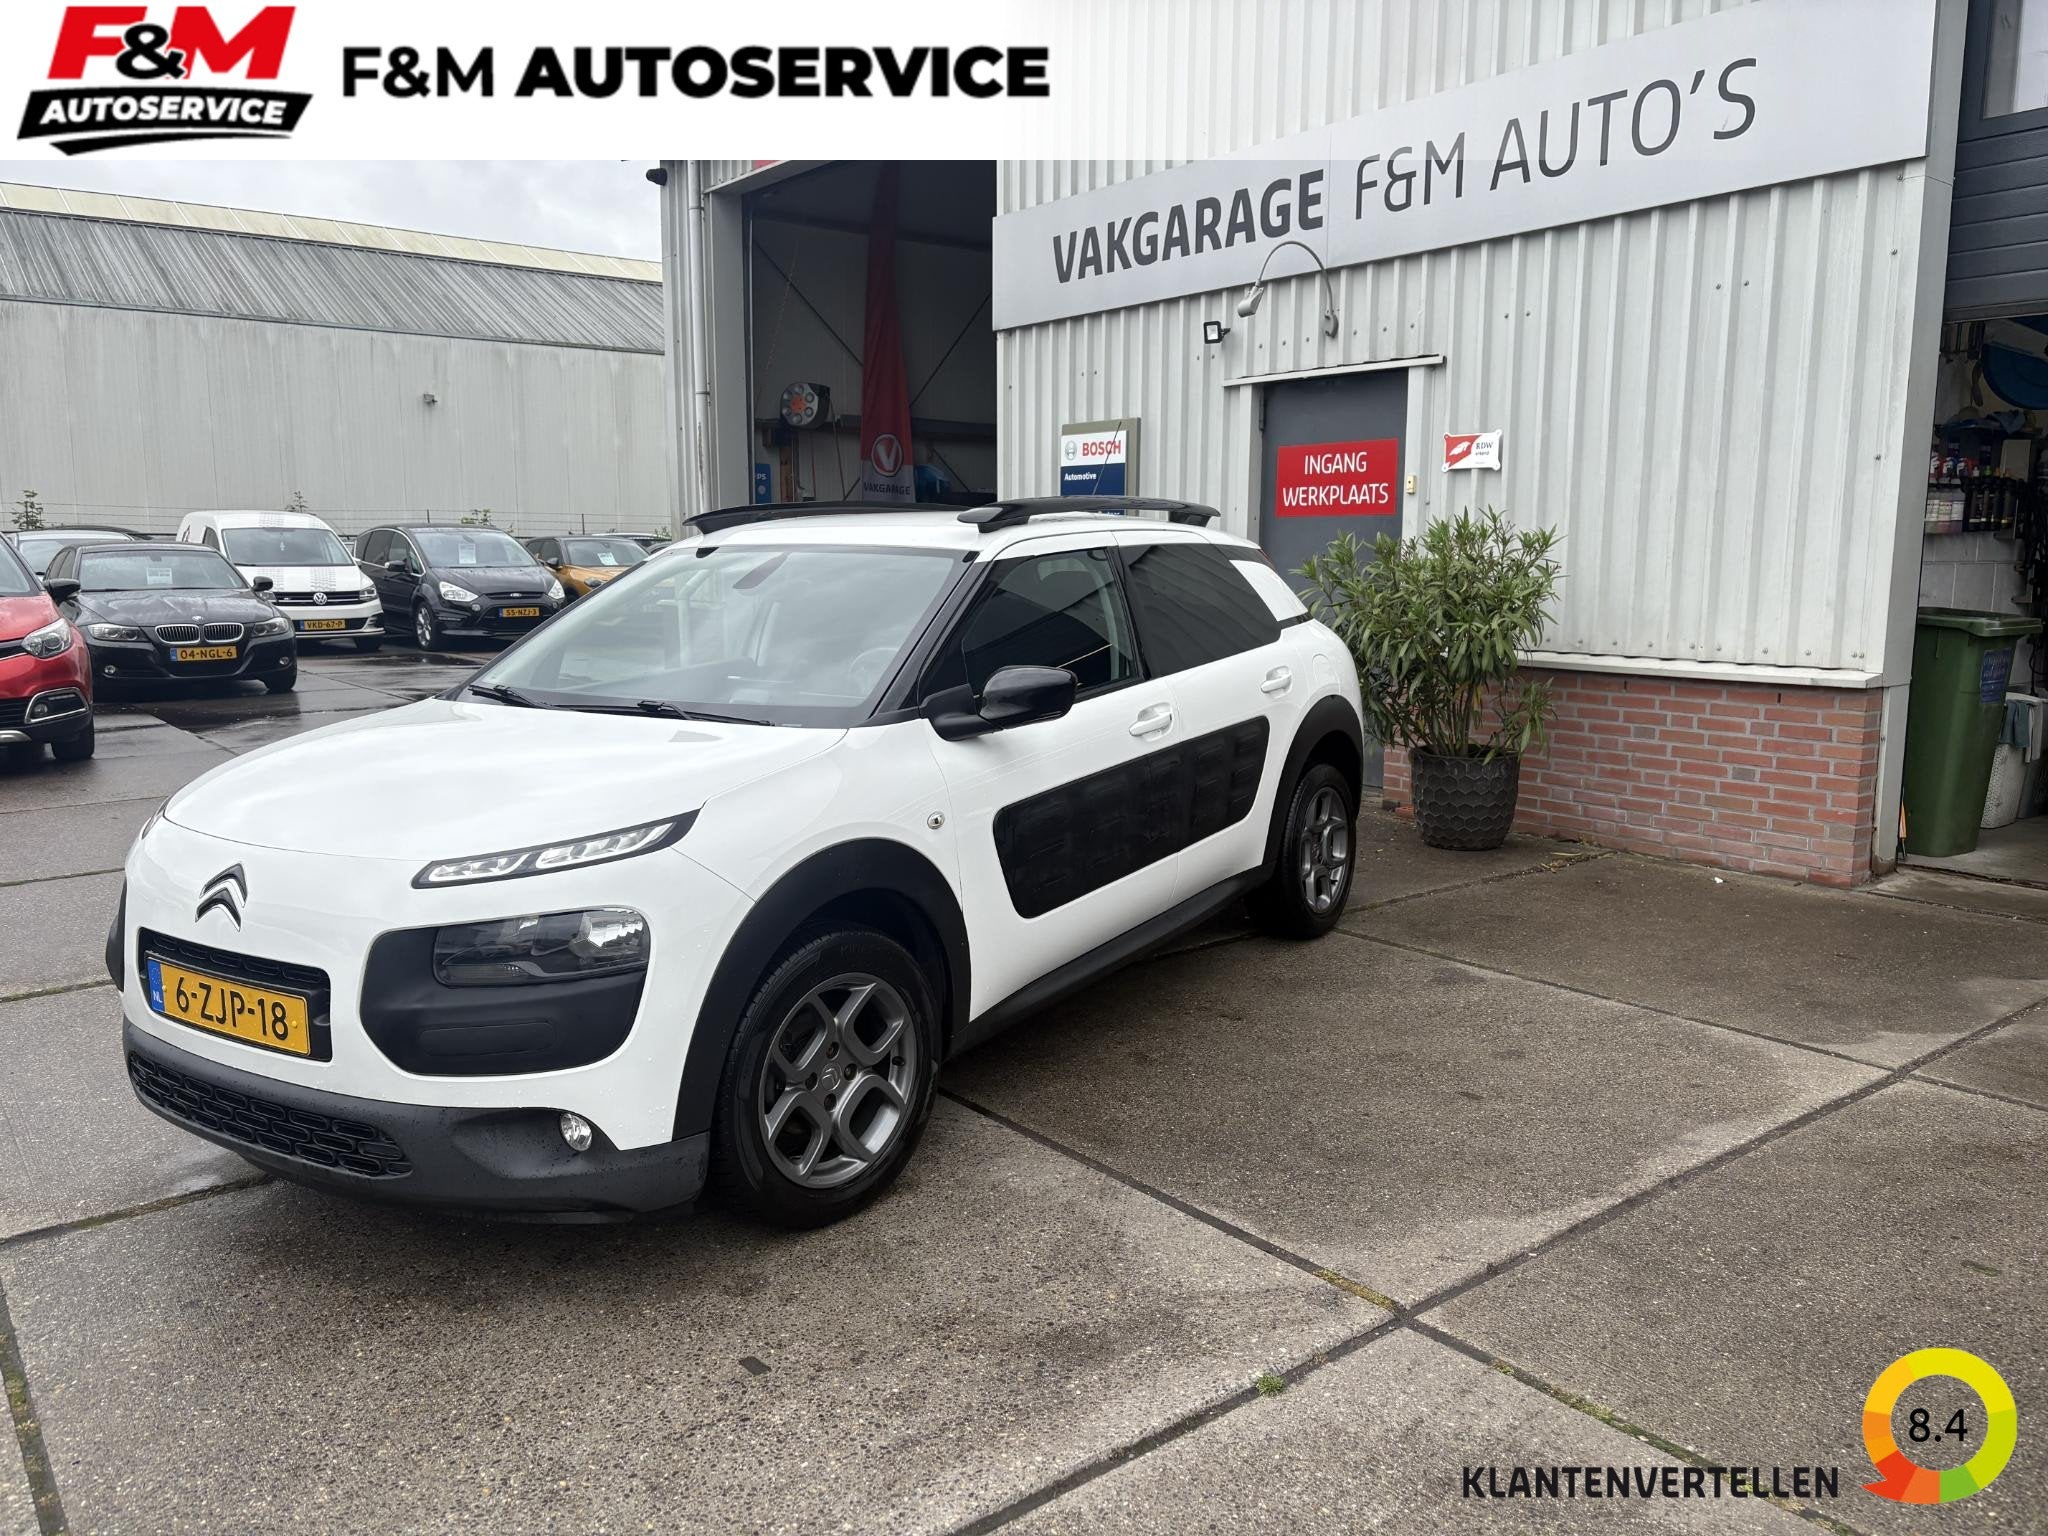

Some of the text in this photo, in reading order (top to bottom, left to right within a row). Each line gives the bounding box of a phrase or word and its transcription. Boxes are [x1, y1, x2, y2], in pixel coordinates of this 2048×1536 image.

[1052, 58, 1757, 284] VAKGARAGE F&M AUTO'S
[1082, 440, 1121, 457] BOSCH
[1475, 441, 1494, 450] RDW
[1304, 451, 1367, 475] INGANG
[1064, 472, 1097, 481] Automotive
[1282, 483, 1389, 507] WERKPLAATS
[180, 649, 233, 660] 04-NGL-6
[152, 977, 288, 1041] NL 6-ZJP-18
